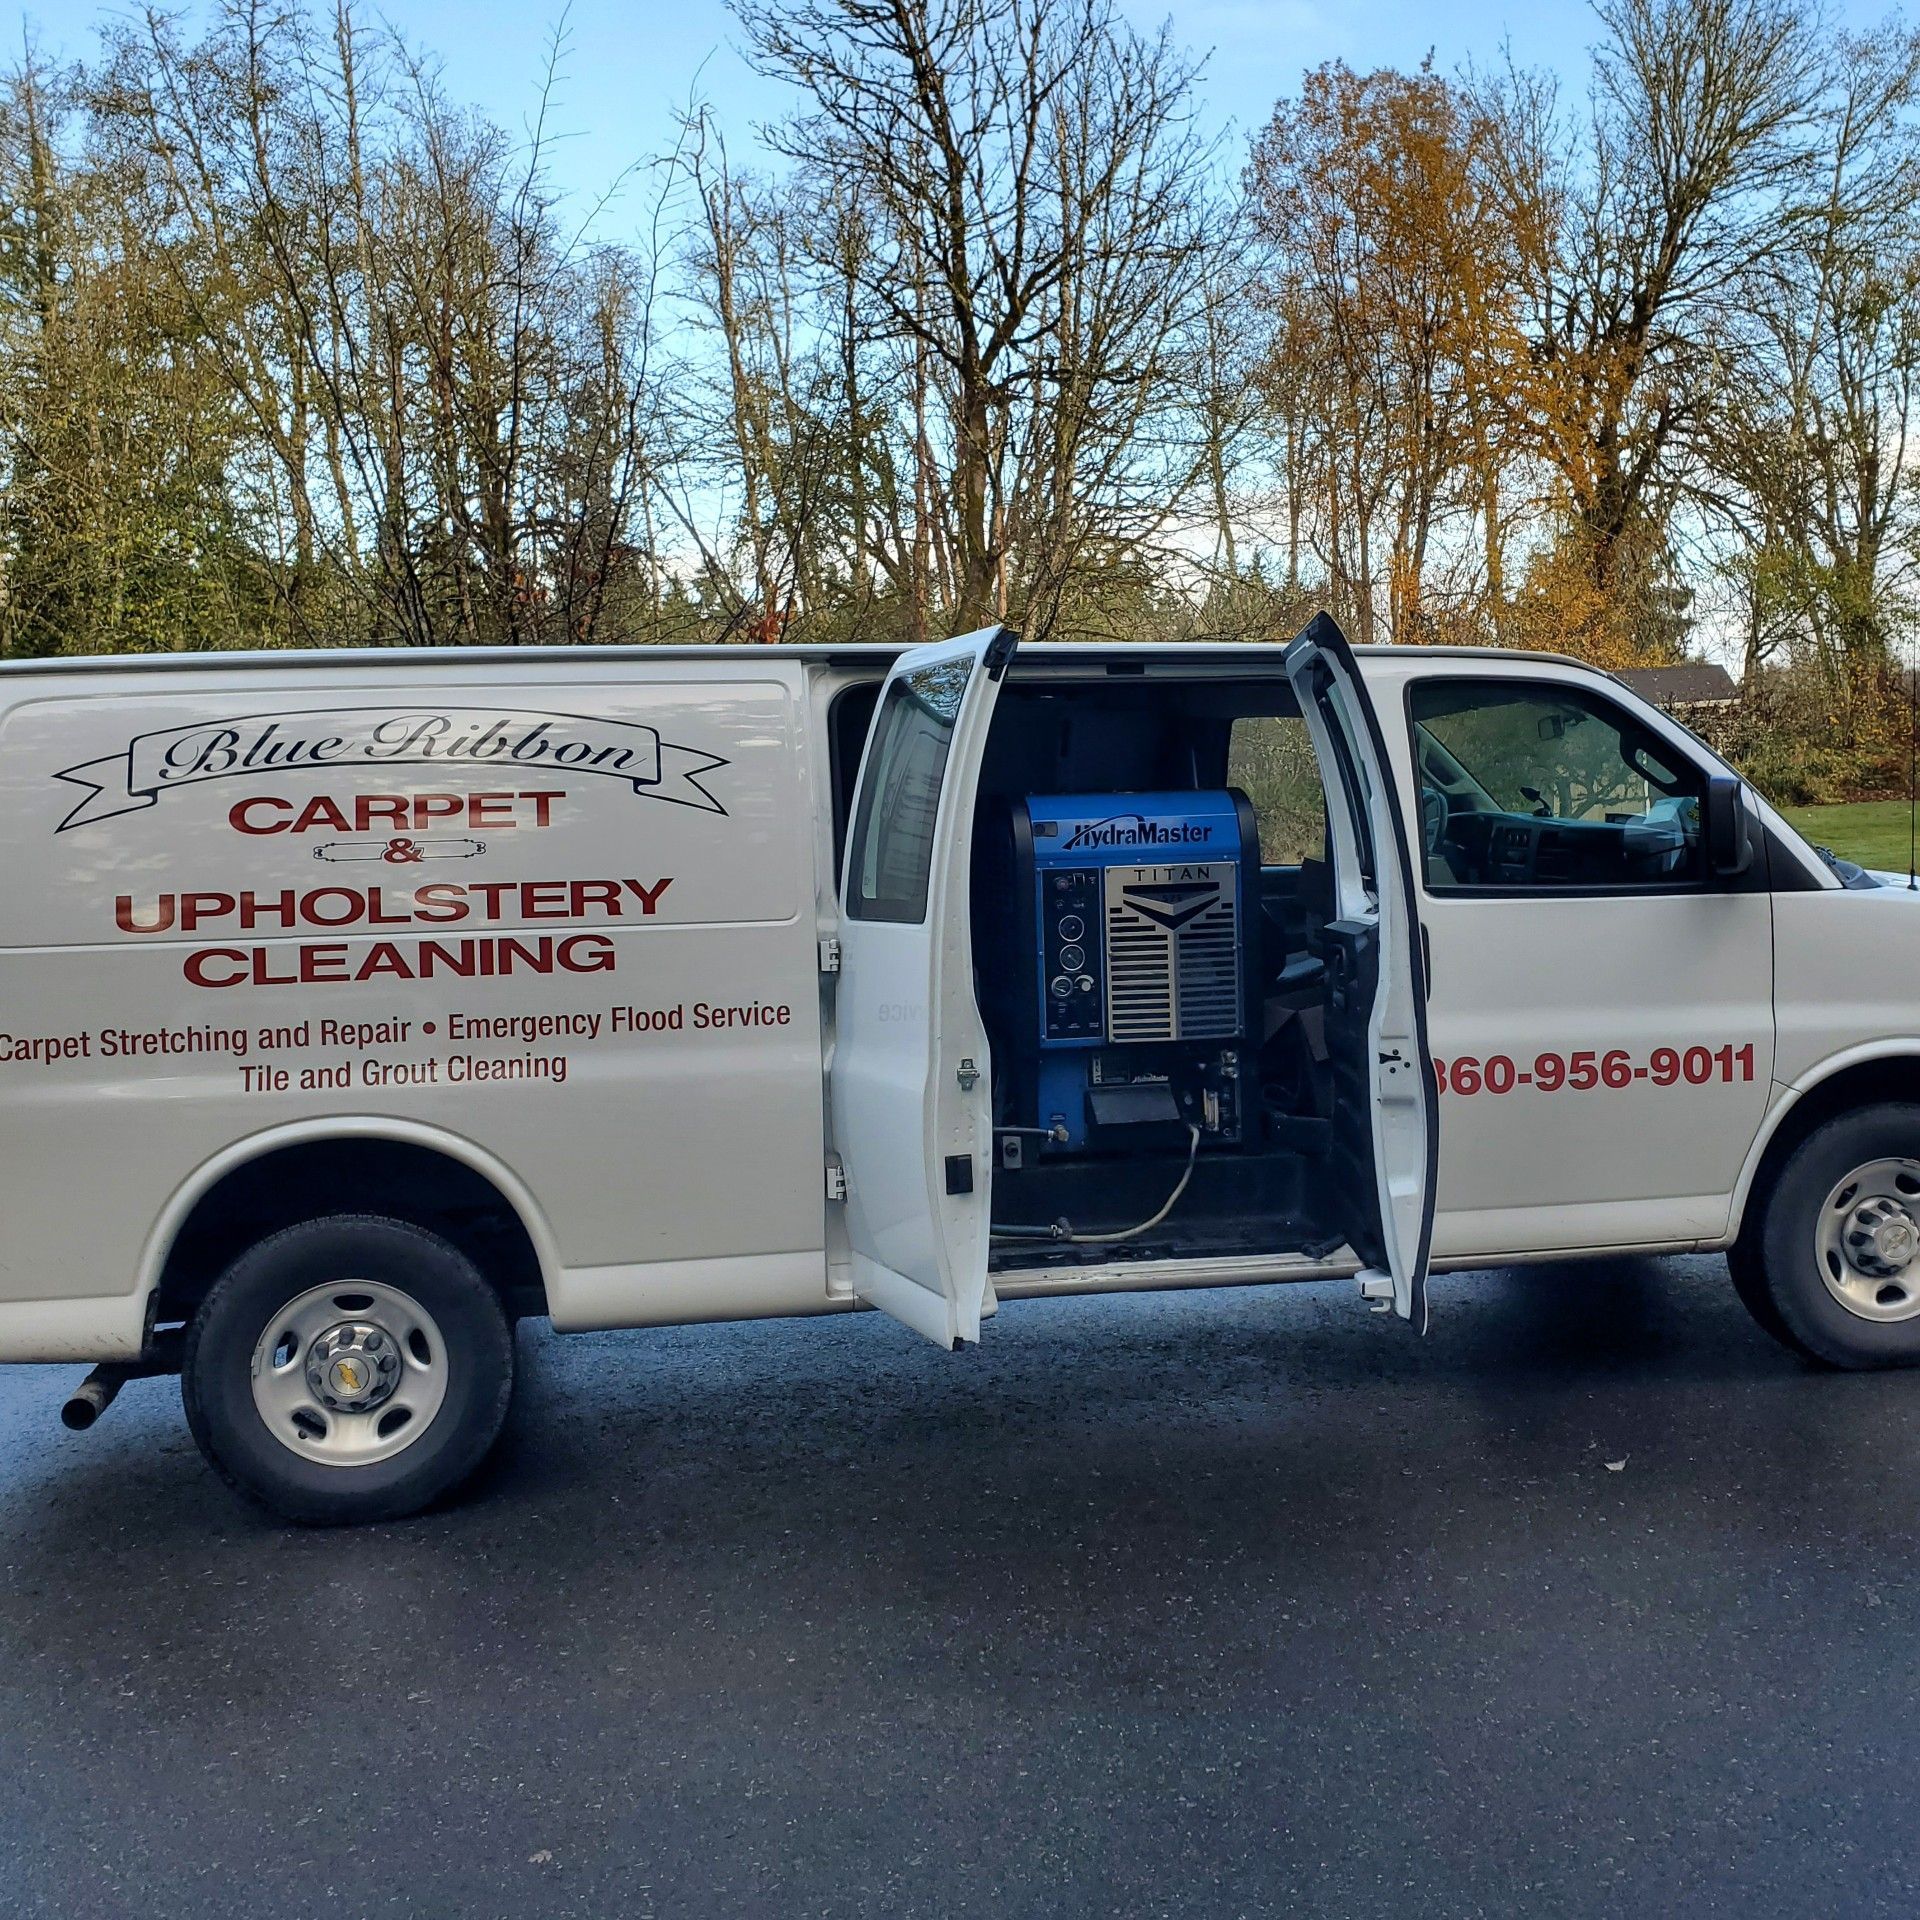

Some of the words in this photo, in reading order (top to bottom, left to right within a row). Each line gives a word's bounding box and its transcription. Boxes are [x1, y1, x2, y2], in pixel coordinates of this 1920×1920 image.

[159, 722, 352, 780] Blue
[364, 714, 646, 770] Ribbon
[229, 791, 566, 835] CARPET
[1068, 818, 1212, 850] HydraMaster
[383, 838, 424, 865] &
[1134, 867, 1209, 882] TITAN
[115, 878, 674, 933] UPHOLSTERY
[184, 934, 616, 988] CLEANING
[0, 1031, 90, 1065] Carpet
[101, 1025, 248, 1056] Stretching
[260, 1021, 309, 1049] and
[321, 1017, 411, 1049] Repair
[449, 1013, 601, 1042] Emergency
[612, 1004, 683, 1032] Flood
[693, 1001, 791, 1029] Service
[239, 1064, 289, 1092] Tile
[301, 1061, 351, 1089] and
[362, 1059, 438, 1086] Grout
[448, 1052, 567, 1082] Cleaning
